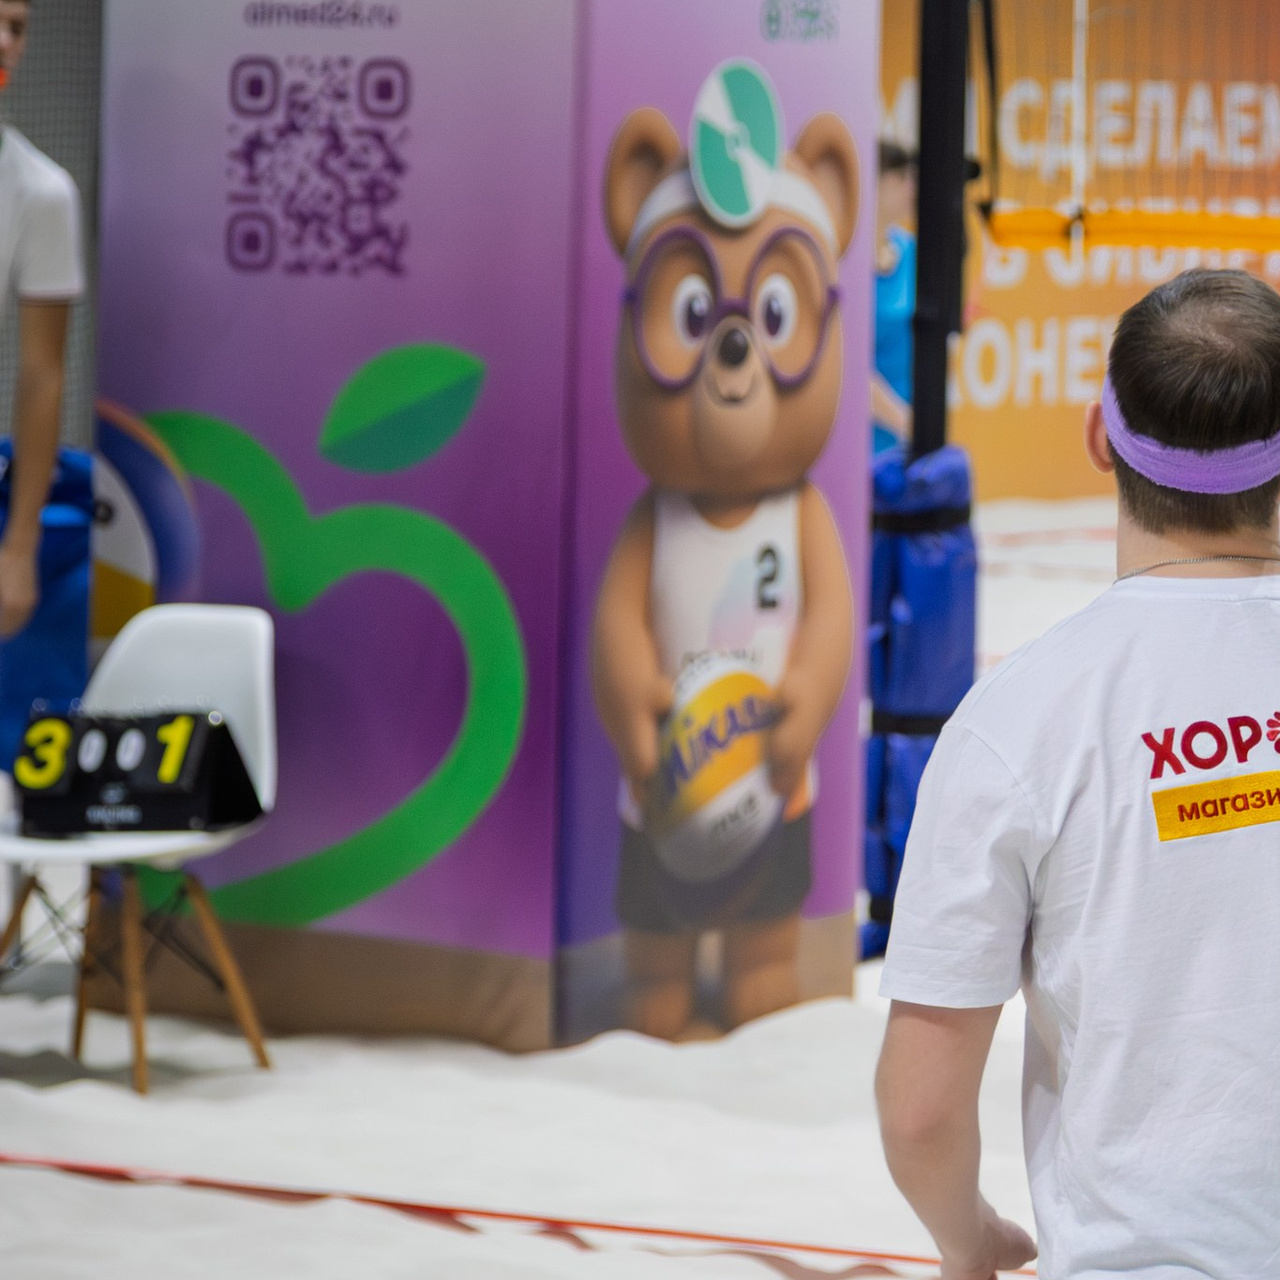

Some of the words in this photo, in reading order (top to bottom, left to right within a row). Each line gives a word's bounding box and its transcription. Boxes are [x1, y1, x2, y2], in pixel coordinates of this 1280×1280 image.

[756, 544, 780, 611] 2
[14, 718, 73, 790] 3
[156, 715, 194, 784] 1
